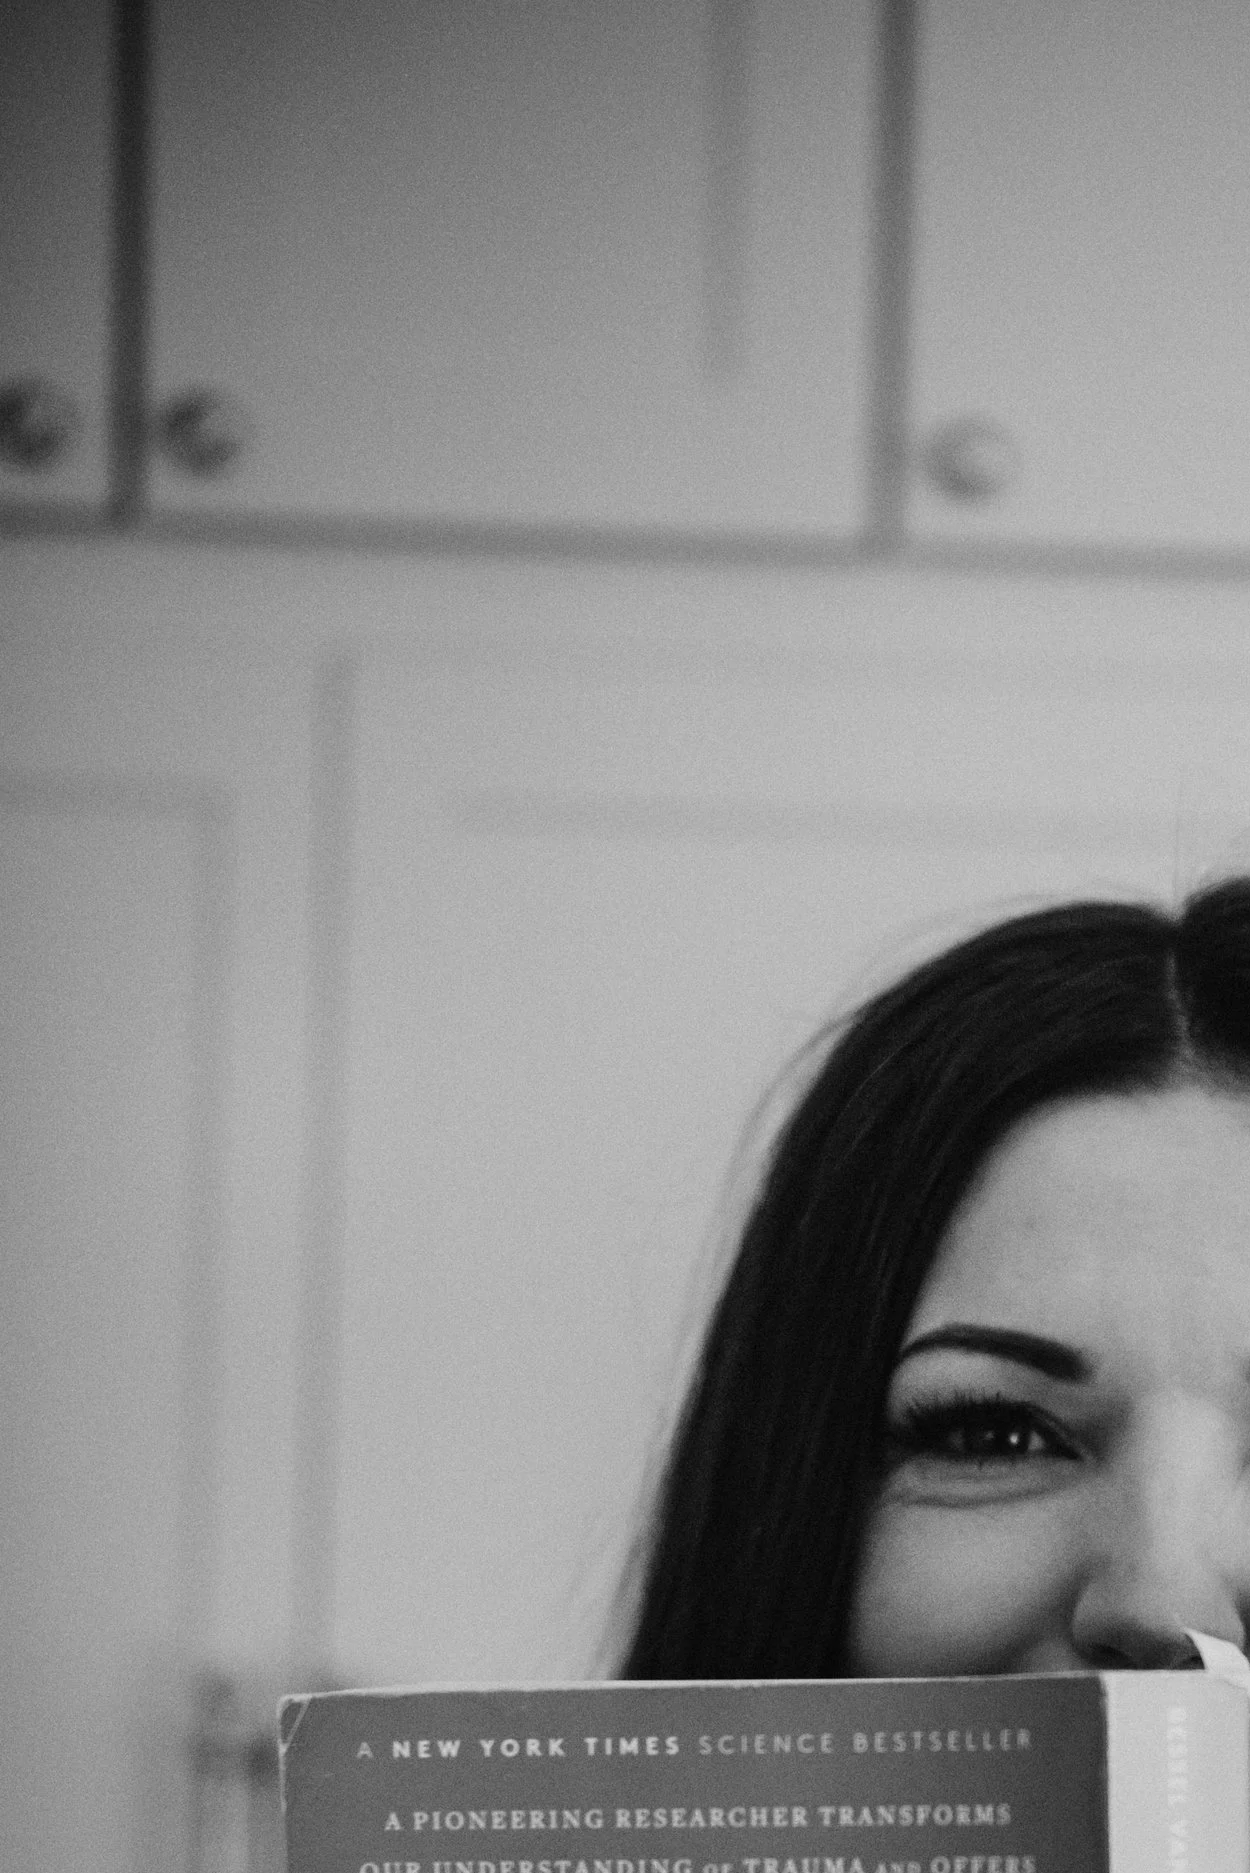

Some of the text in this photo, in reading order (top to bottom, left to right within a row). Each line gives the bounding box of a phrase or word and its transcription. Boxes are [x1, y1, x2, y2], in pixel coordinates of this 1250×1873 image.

[357, 1730, 1028, 1758] A NEW YORK TIMES SCIENCE BESTSELLER
[385, 1805, 1009, 1830] A PIONEERING RESEARCHER TRANSFORMS
